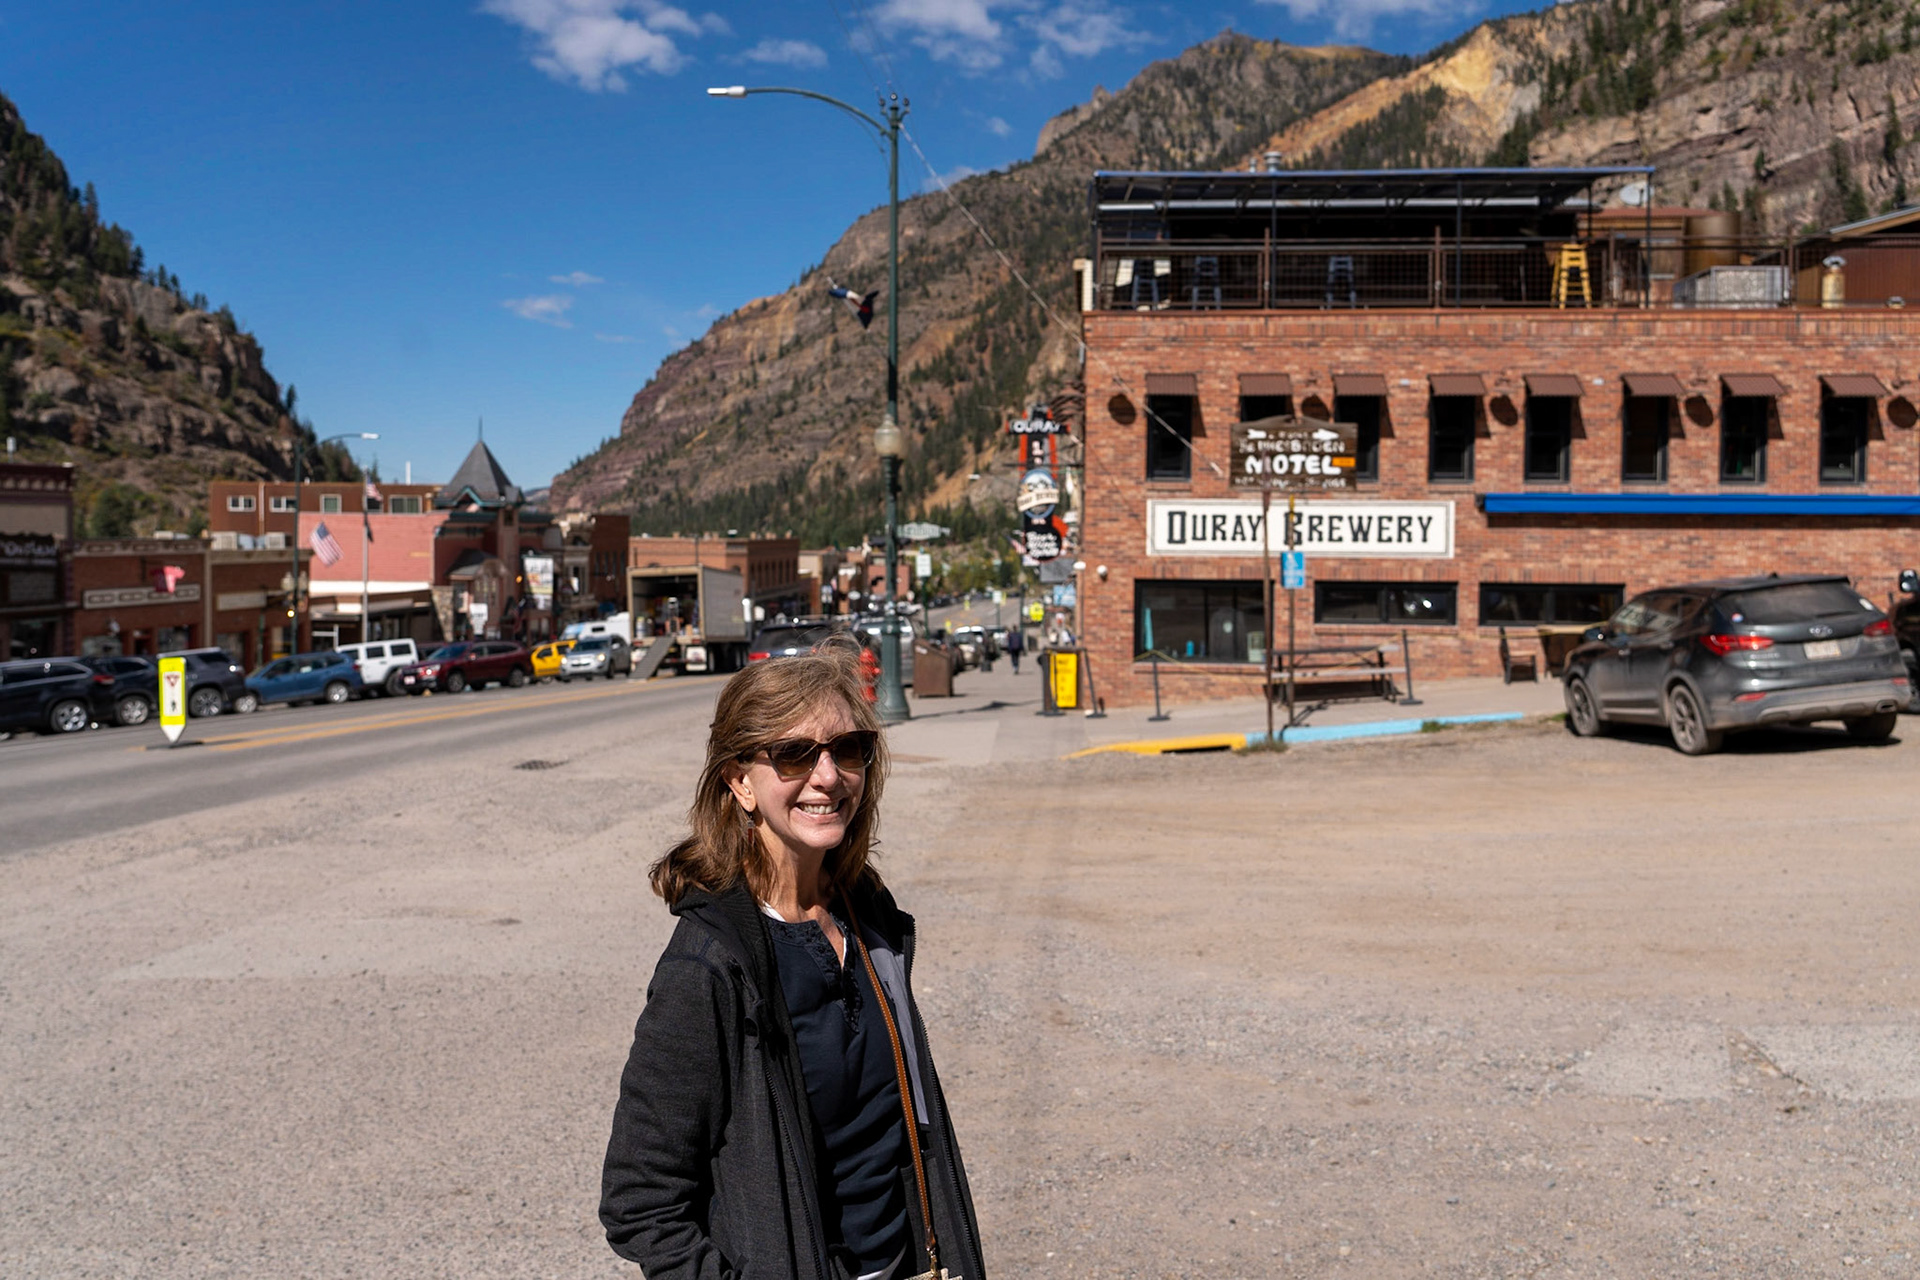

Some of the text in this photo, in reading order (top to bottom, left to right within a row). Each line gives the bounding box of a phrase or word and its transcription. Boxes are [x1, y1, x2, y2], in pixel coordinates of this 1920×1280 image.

[1244, 454, 1342, 475] MOTEL
[1168, 511, 1434, 545] OURAY BREWERY
